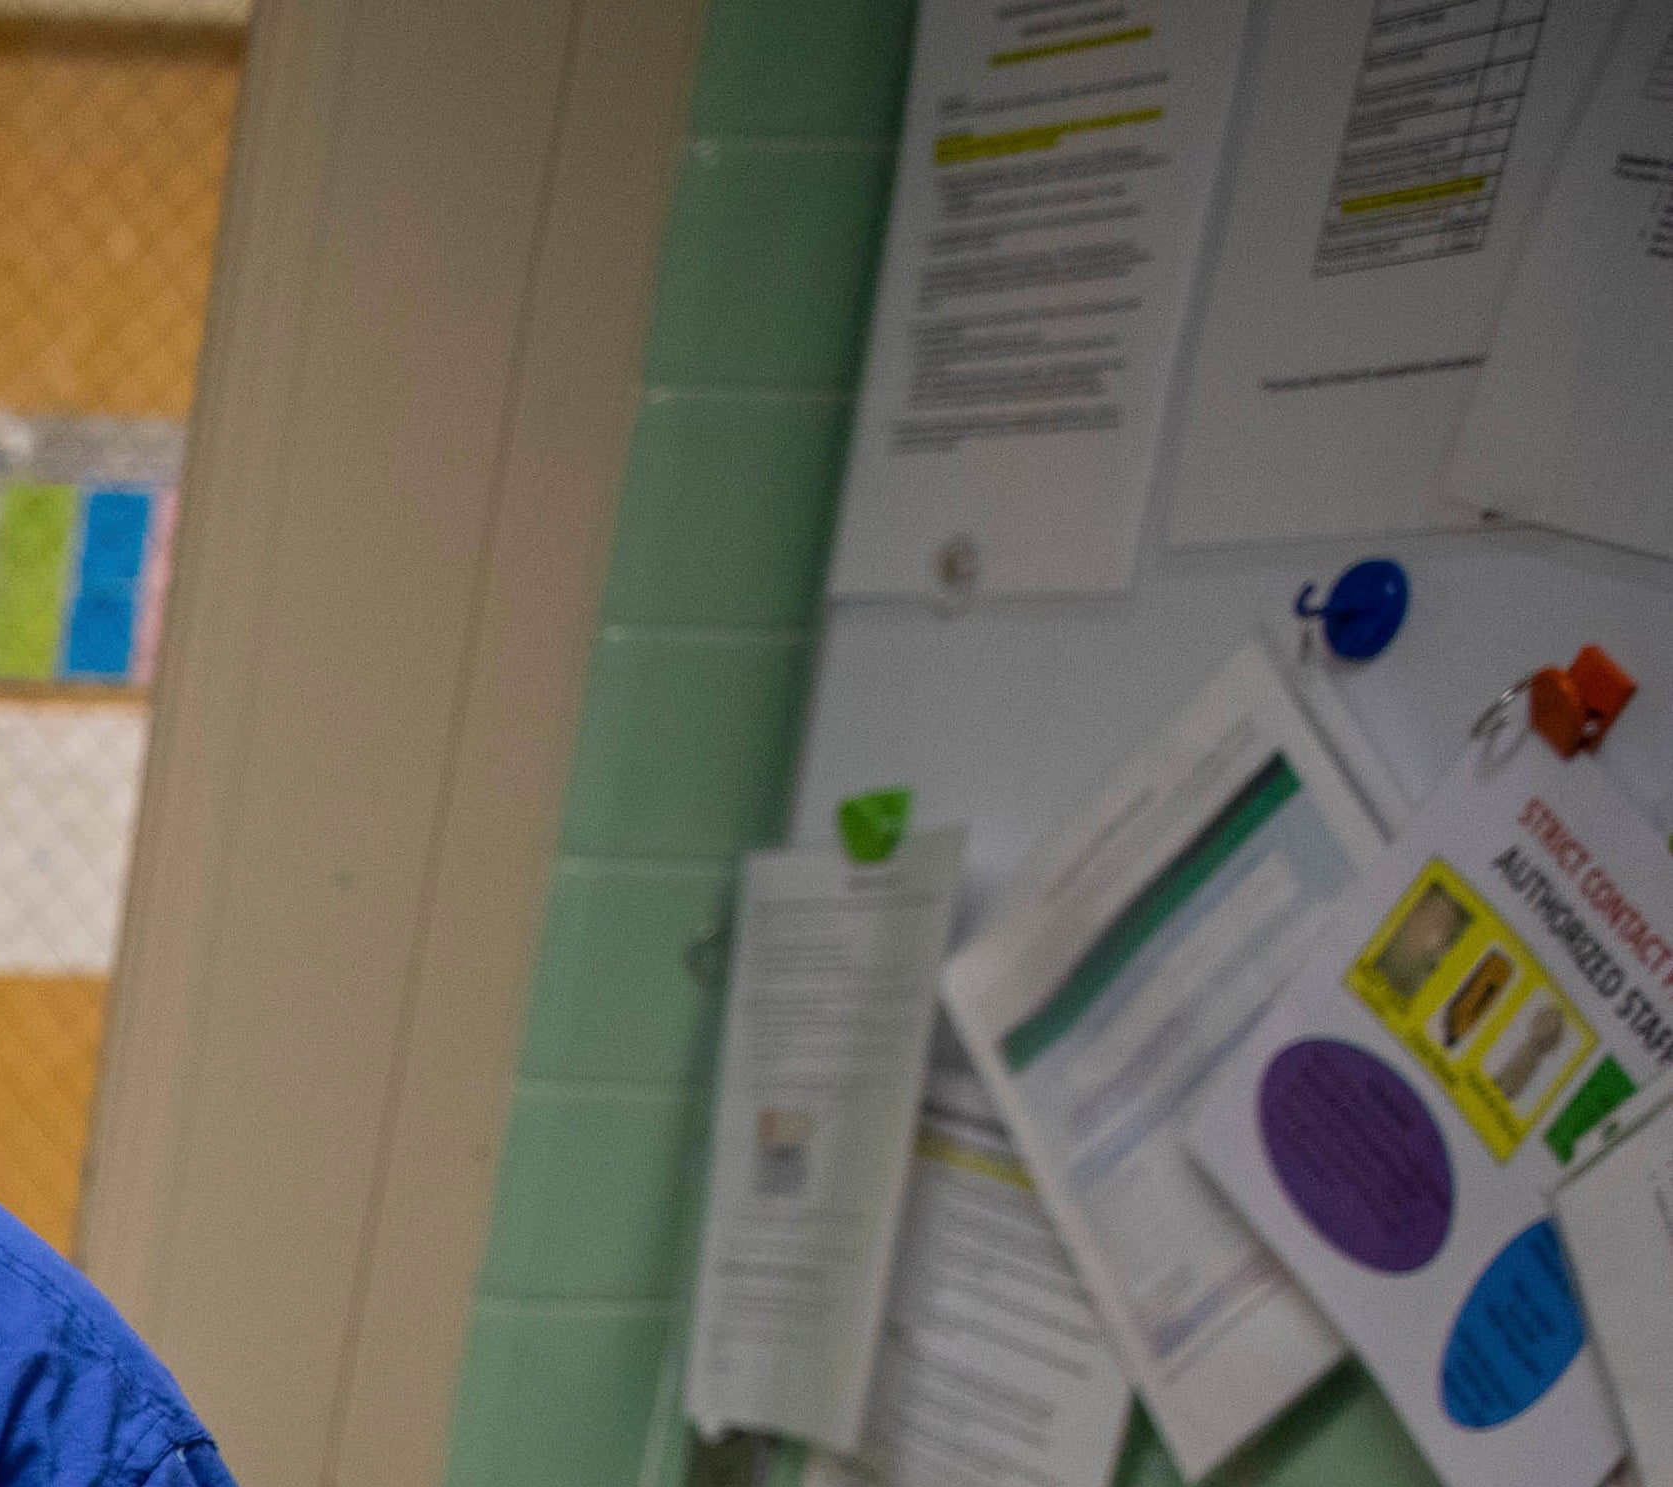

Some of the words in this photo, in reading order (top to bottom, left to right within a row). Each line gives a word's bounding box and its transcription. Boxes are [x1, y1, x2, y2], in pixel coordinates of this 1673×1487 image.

[1491, 846, 1625, 998] AUTHORIZED
[1516, 796, 1591, 877] STRICT
[1579, 867, 1673, 973] CONTACT
